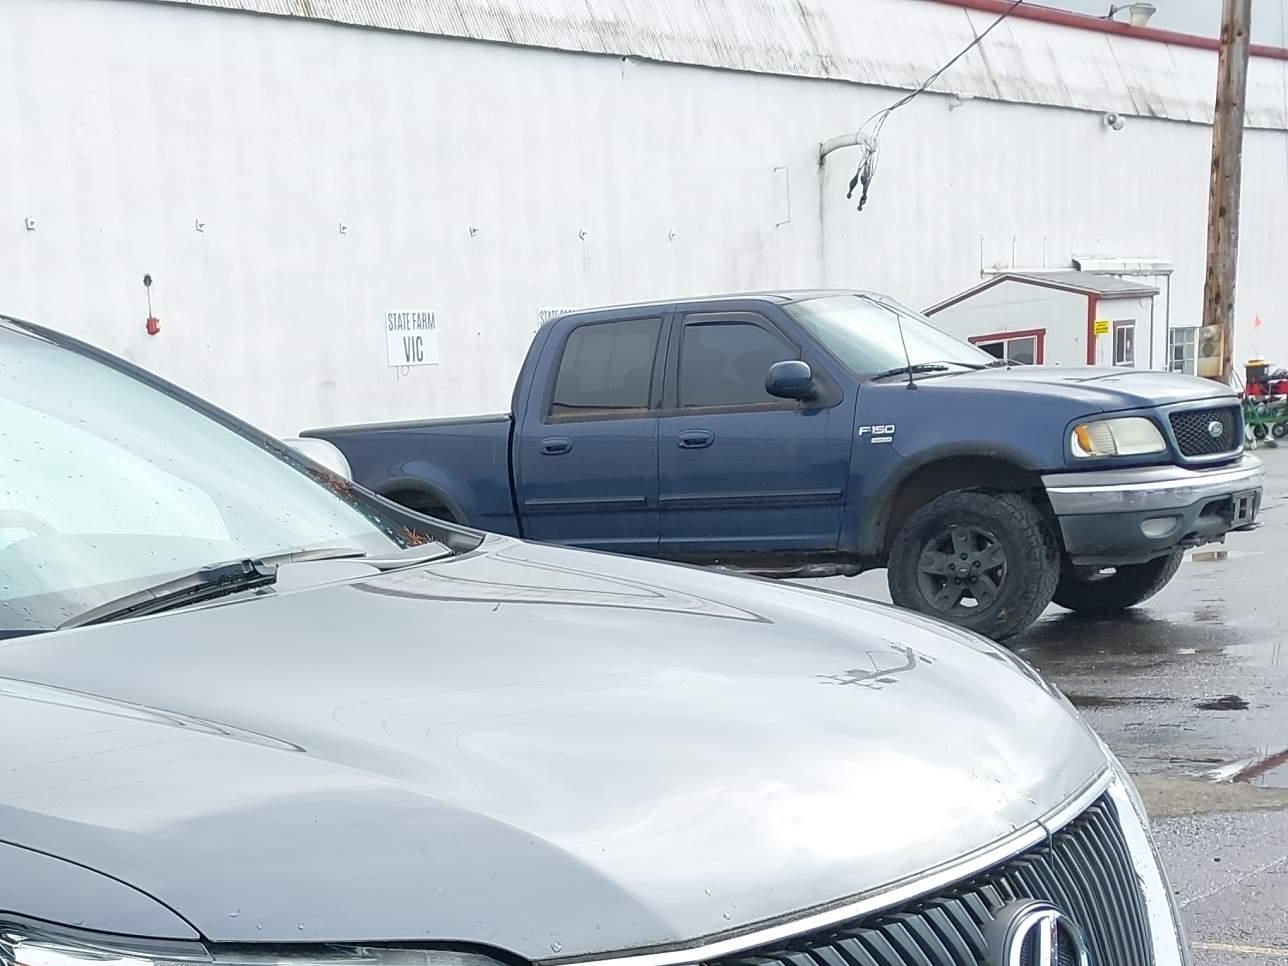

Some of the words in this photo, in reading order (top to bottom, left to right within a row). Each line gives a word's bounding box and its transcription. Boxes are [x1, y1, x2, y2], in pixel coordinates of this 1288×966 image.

[387, 312, 411, 331] STATE
[412, 312, 436, 330] FARM
[403, 336, 424, 362] VIC
